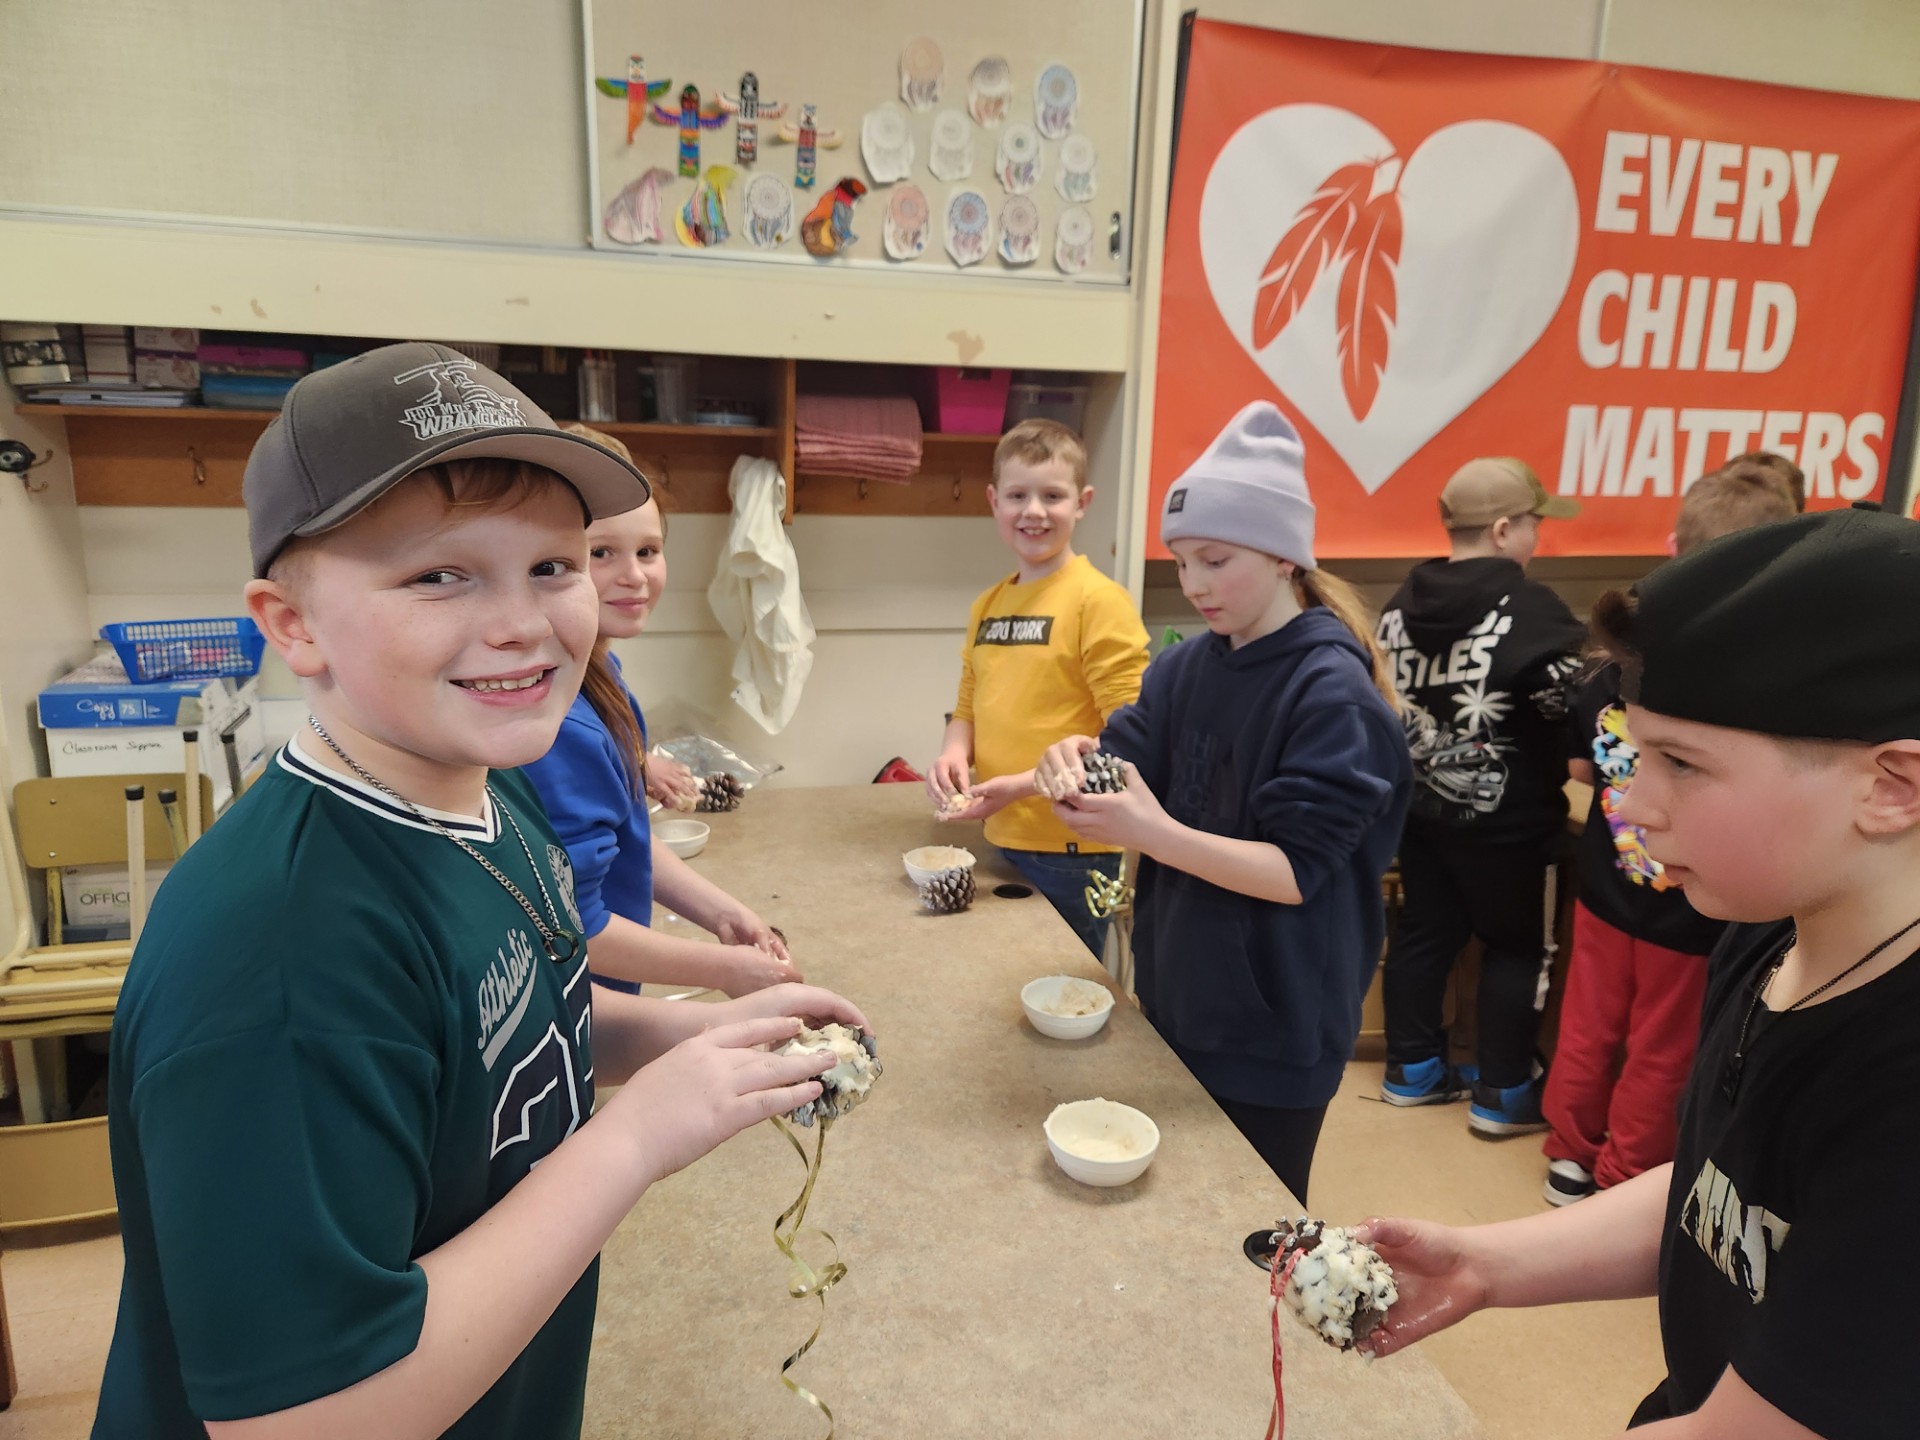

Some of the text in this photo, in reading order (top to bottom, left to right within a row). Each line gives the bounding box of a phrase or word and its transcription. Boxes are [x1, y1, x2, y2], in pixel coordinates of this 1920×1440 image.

[1594, 130, 1839, 247] EVERY
[1577, 269, 1797, 373] CHILD
[416, 409, 521, 438] WRANGLERS
[1011, 620, 1047, 640] YORK
[477, 928, 533, 1050] Athletic
